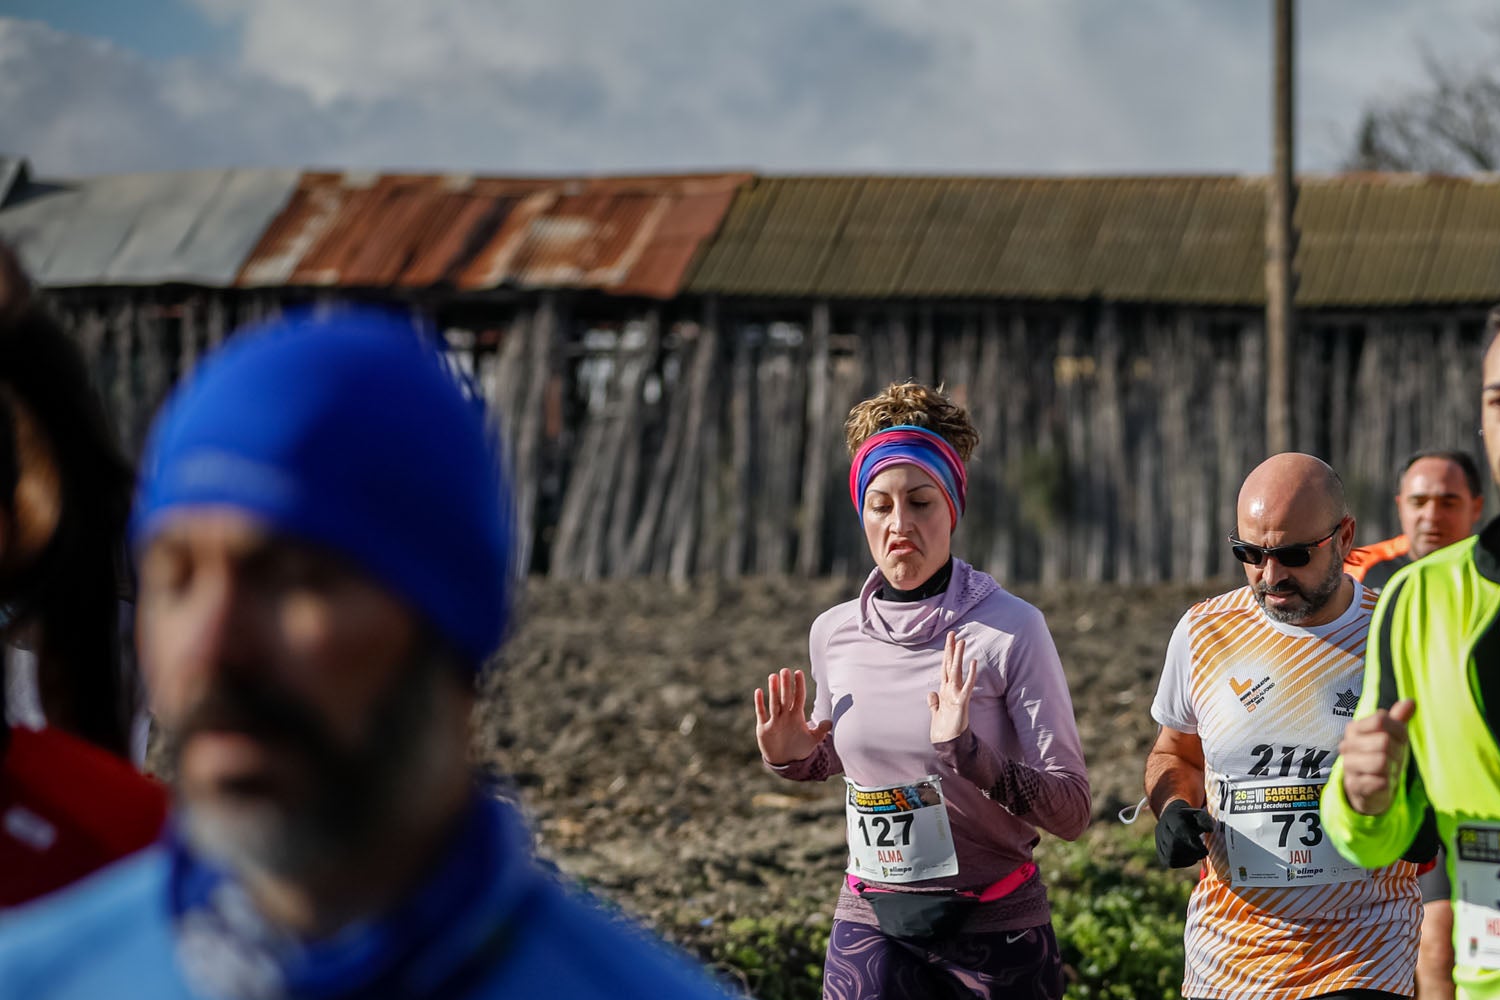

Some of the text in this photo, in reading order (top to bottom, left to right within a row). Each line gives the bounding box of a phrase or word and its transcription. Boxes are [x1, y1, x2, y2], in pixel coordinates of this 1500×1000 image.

[1247, 743, 1331, 779] 21K
[1234, 790, 1247, 800] 26
[1265, 785, 1314, 796] CARRERA
[1265, 794, 1314, 803] POPULAR
[1263, 800, 1292, 809] Secaderos
[858, 813, 914, 847] 127
[1272, 812, 1323, 848] 73
[877, 849, 904, 863] ALMA
[1289, 849, 1312, 865] JAVI
[1297, 868, 1323, 876] olimpo
